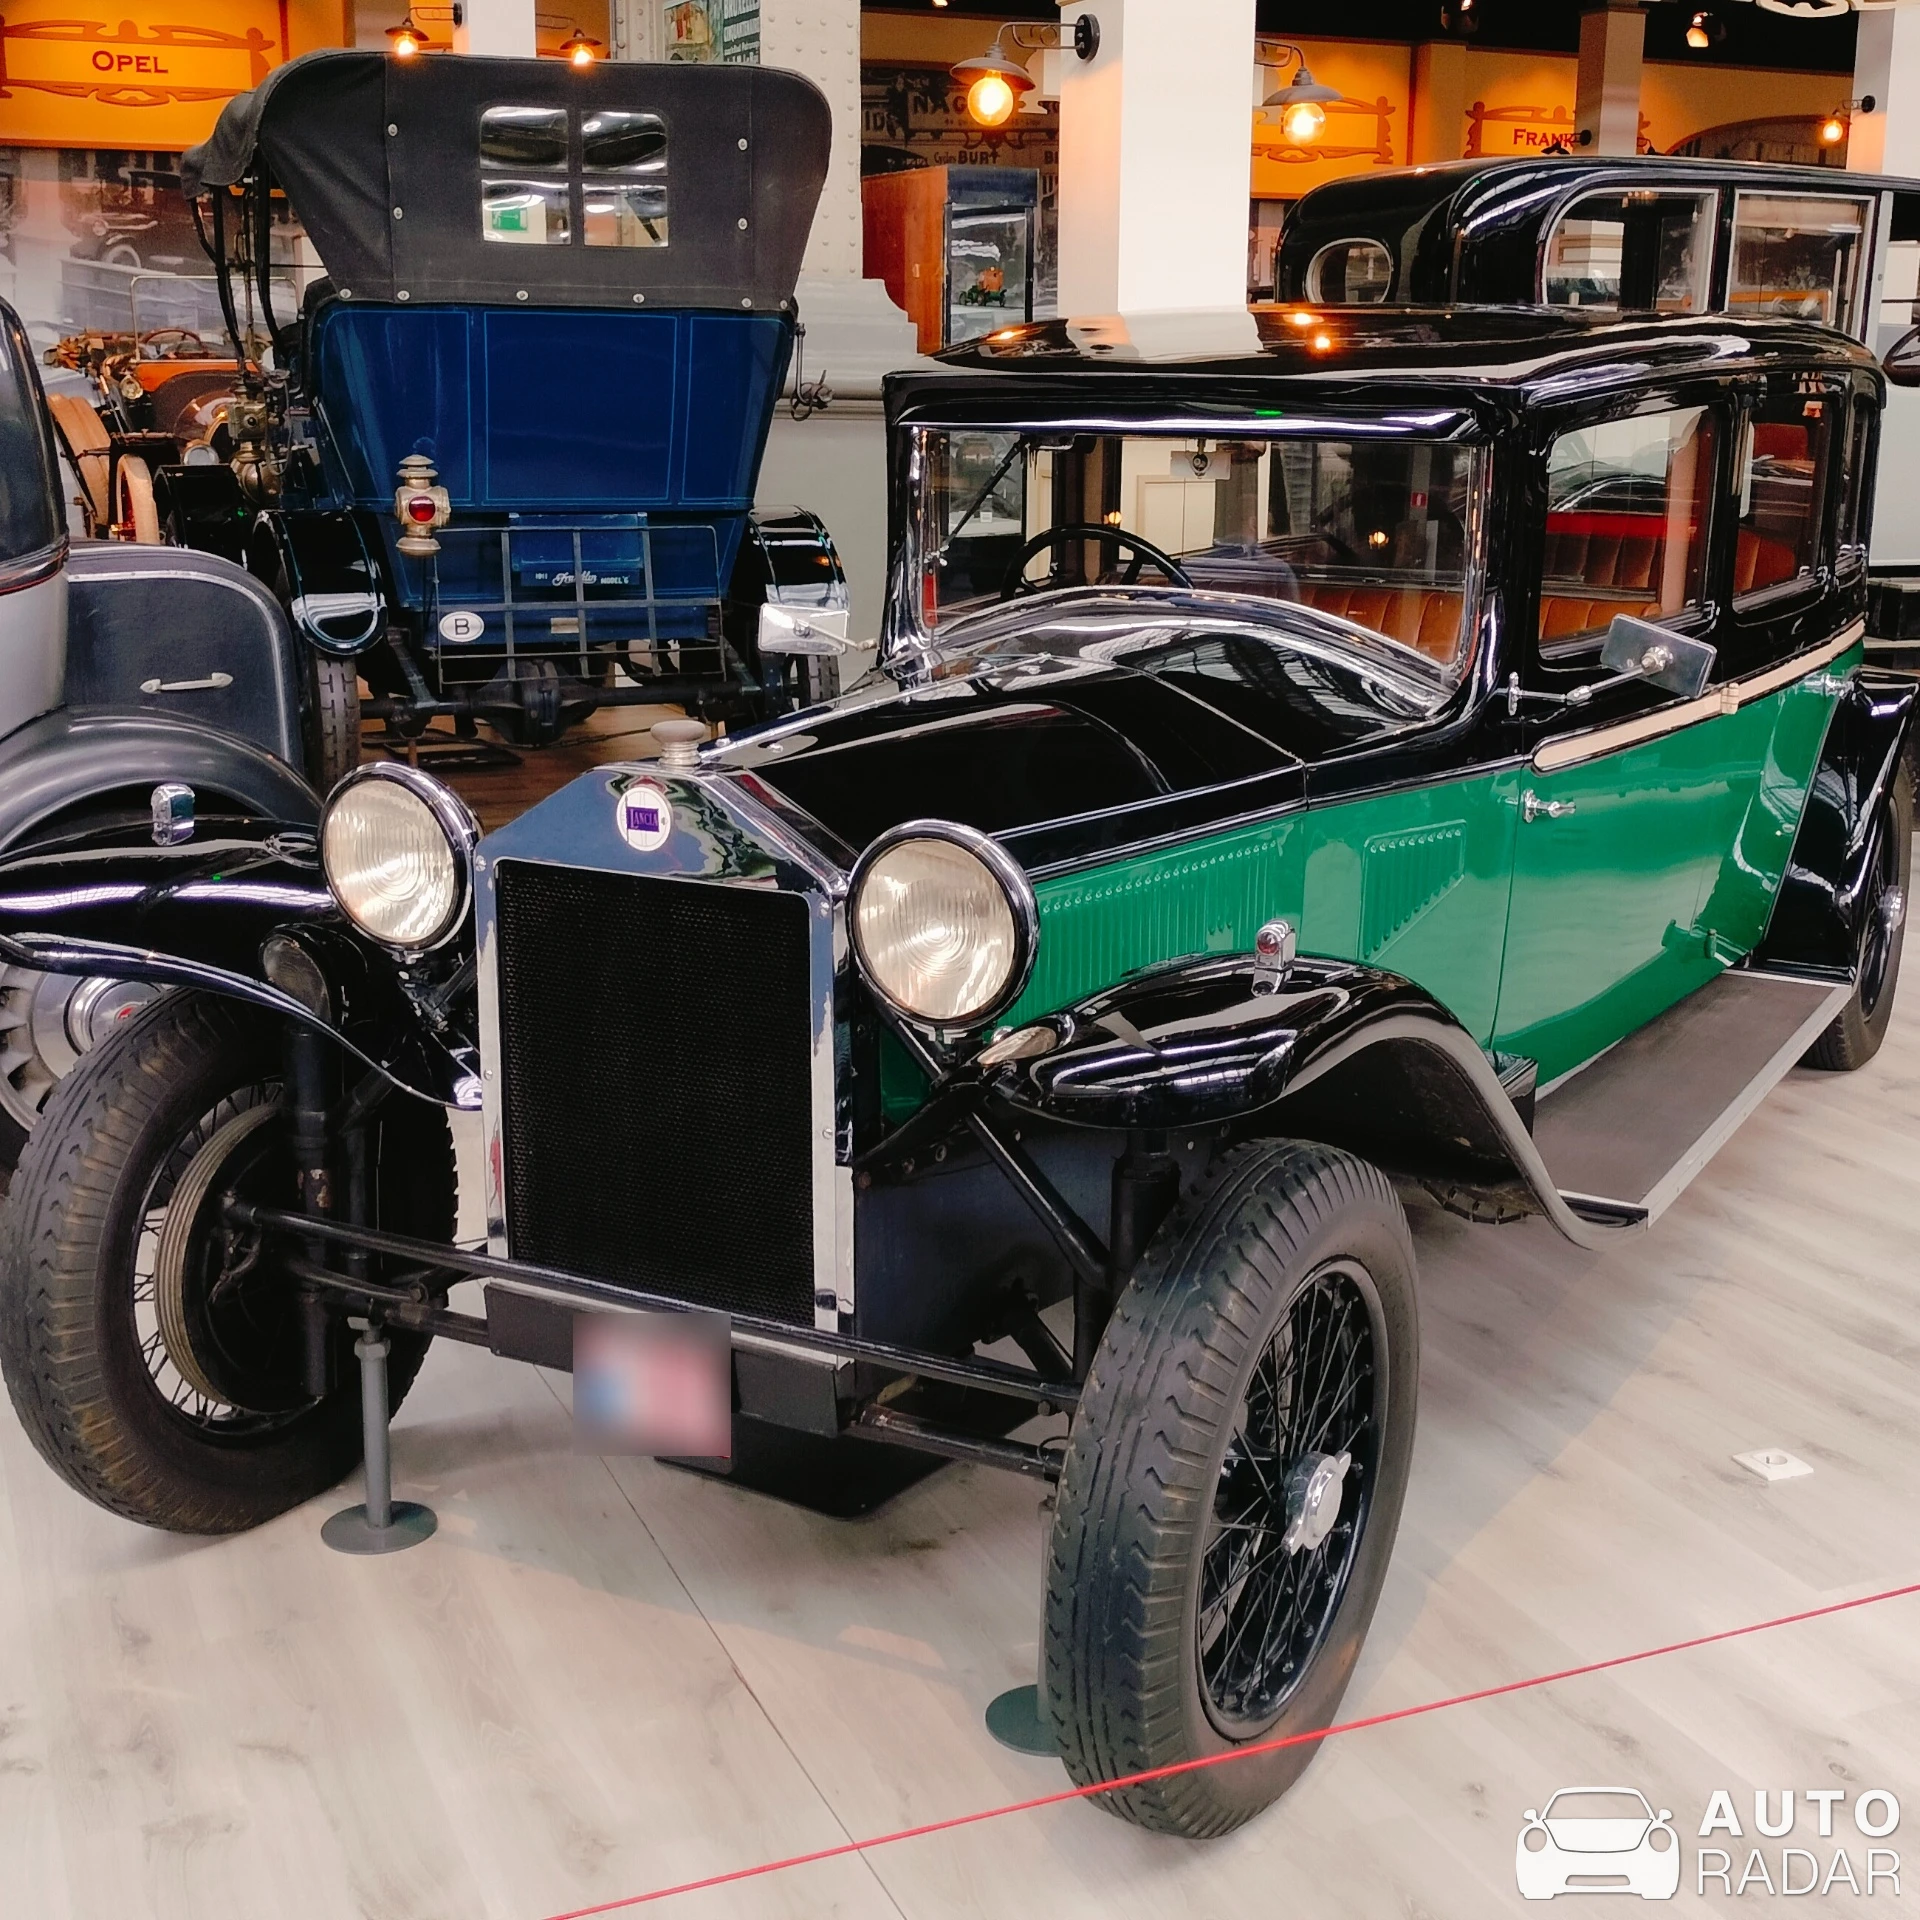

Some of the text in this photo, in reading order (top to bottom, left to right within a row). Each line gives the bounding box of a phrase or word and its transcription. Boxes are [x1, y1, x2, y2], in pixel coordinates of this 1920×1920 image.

[92, 50, 169, 74] OPEL
[454, 618, 470, 635] B
[630, 808, 658, 829] LANCIA
